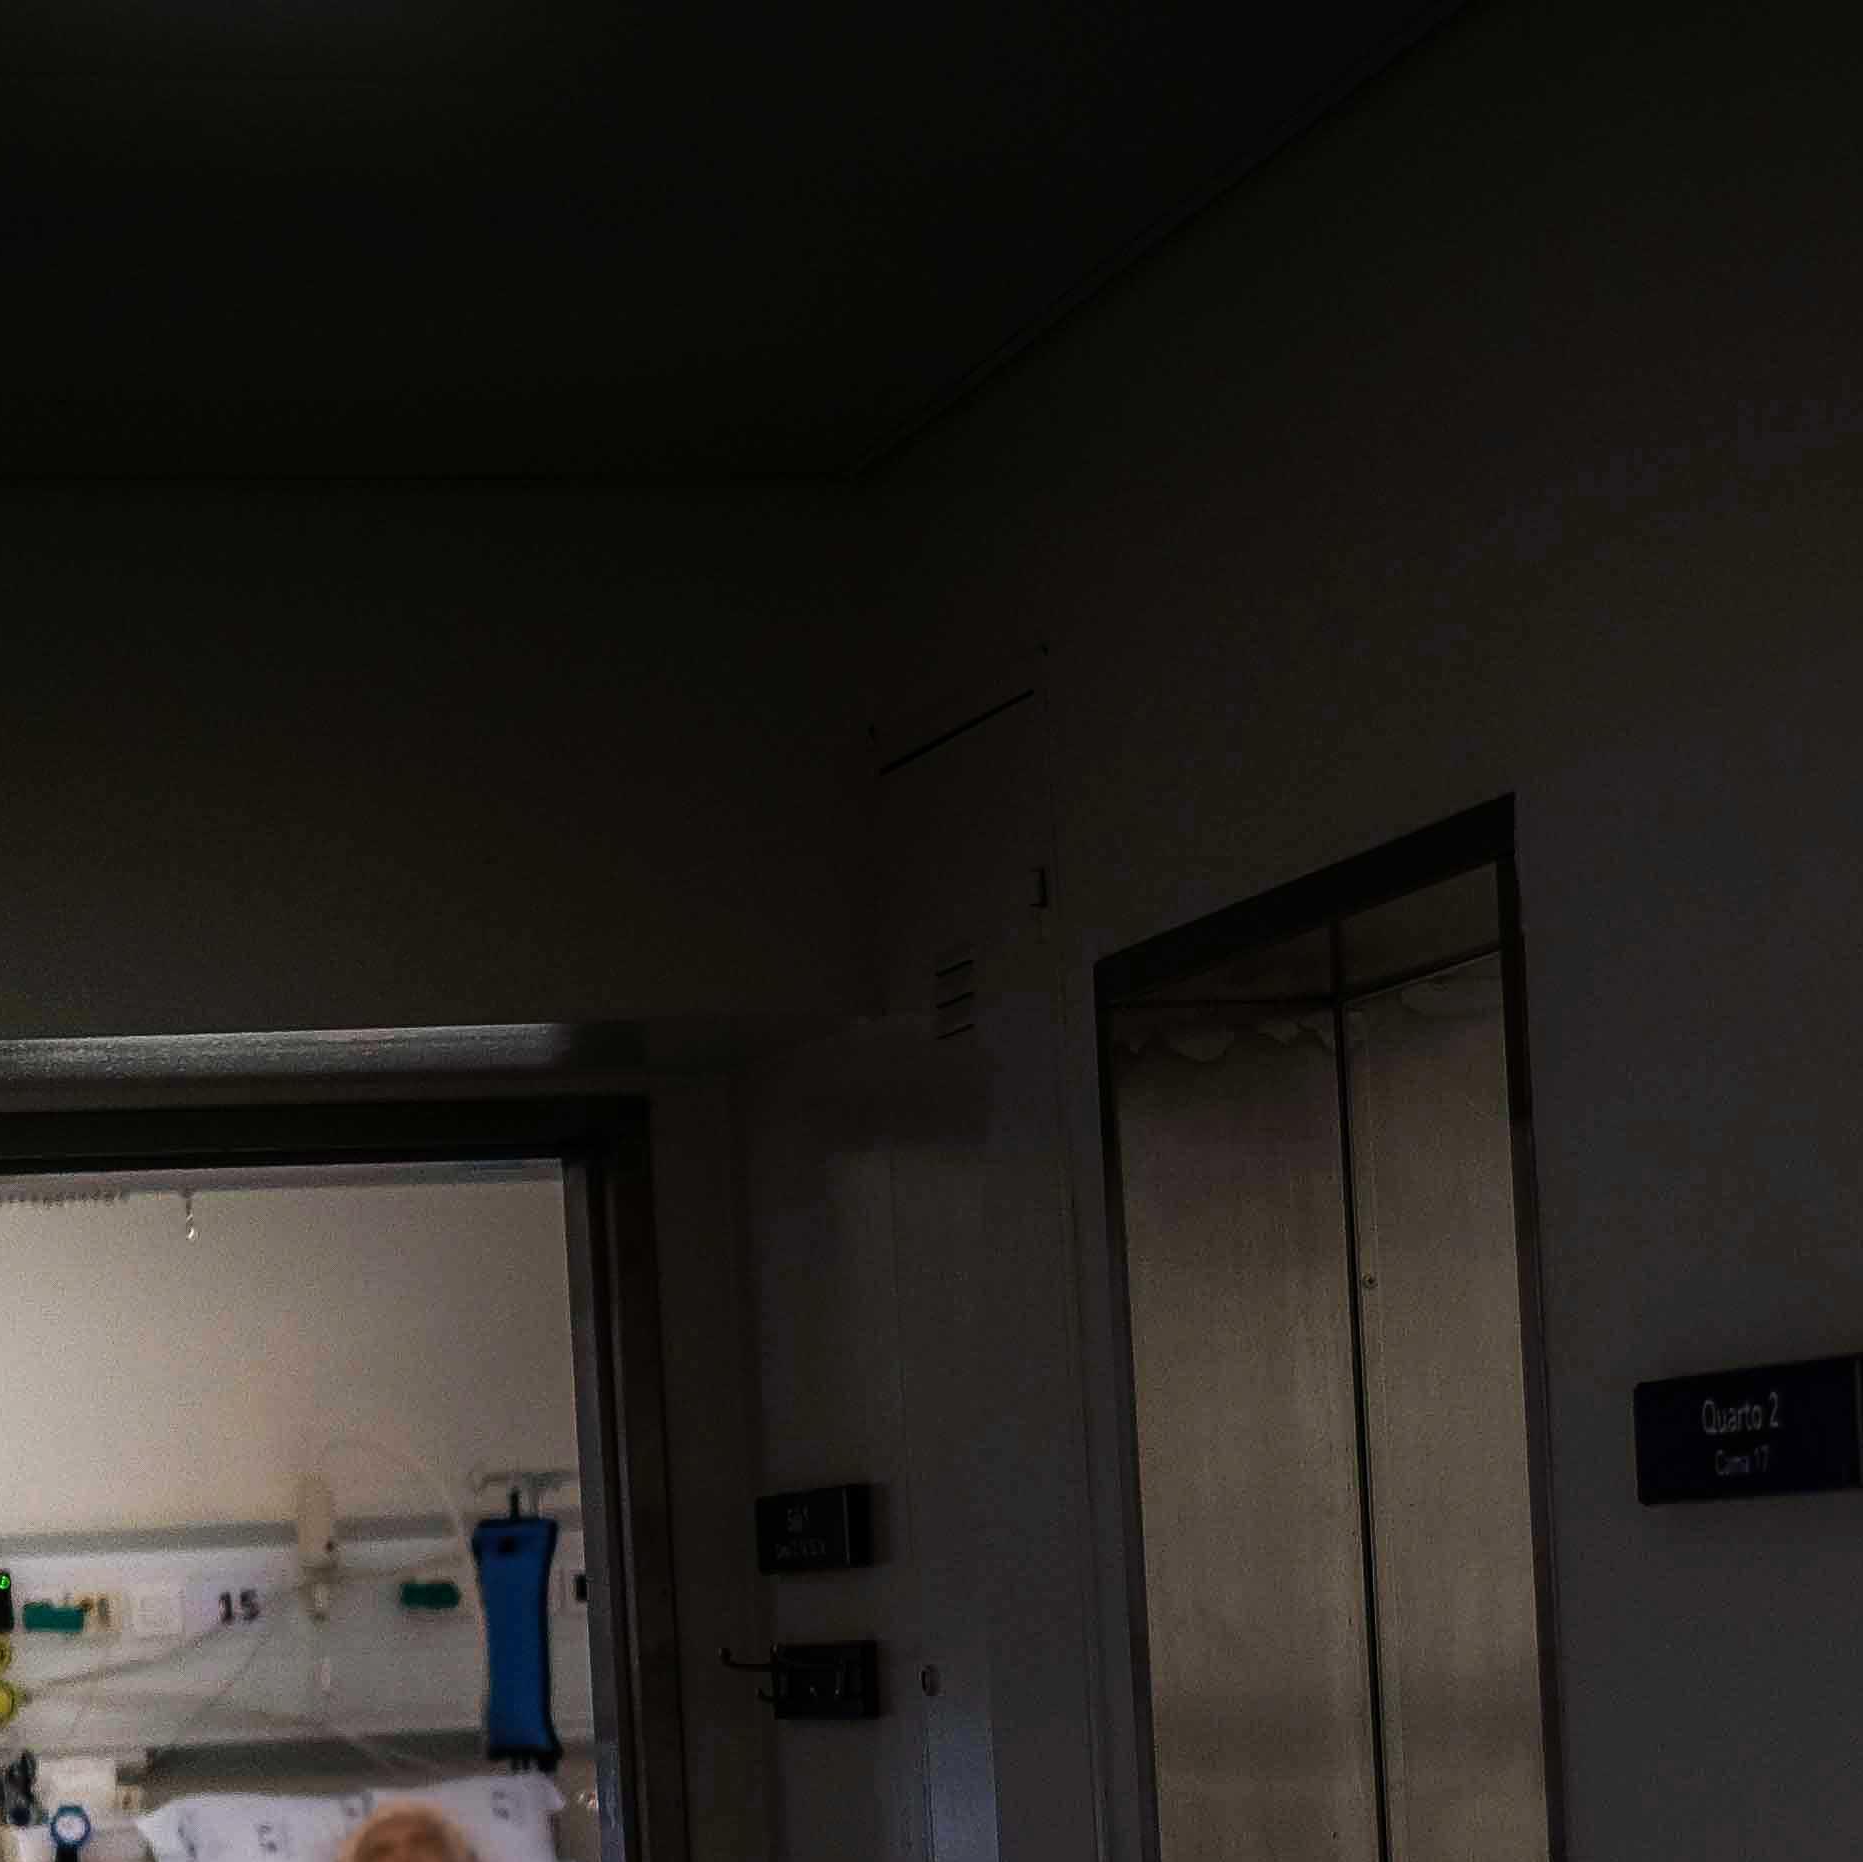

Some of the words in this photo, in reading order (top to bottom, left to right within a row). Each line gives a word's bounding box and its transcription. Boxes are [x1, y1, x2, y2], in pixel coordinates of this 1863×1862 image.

[1700, 1399, 1762, 1435] Quarto
[1768, 1391, 1779, 1429] 2
[220, 1590, 259, 1623] 15
